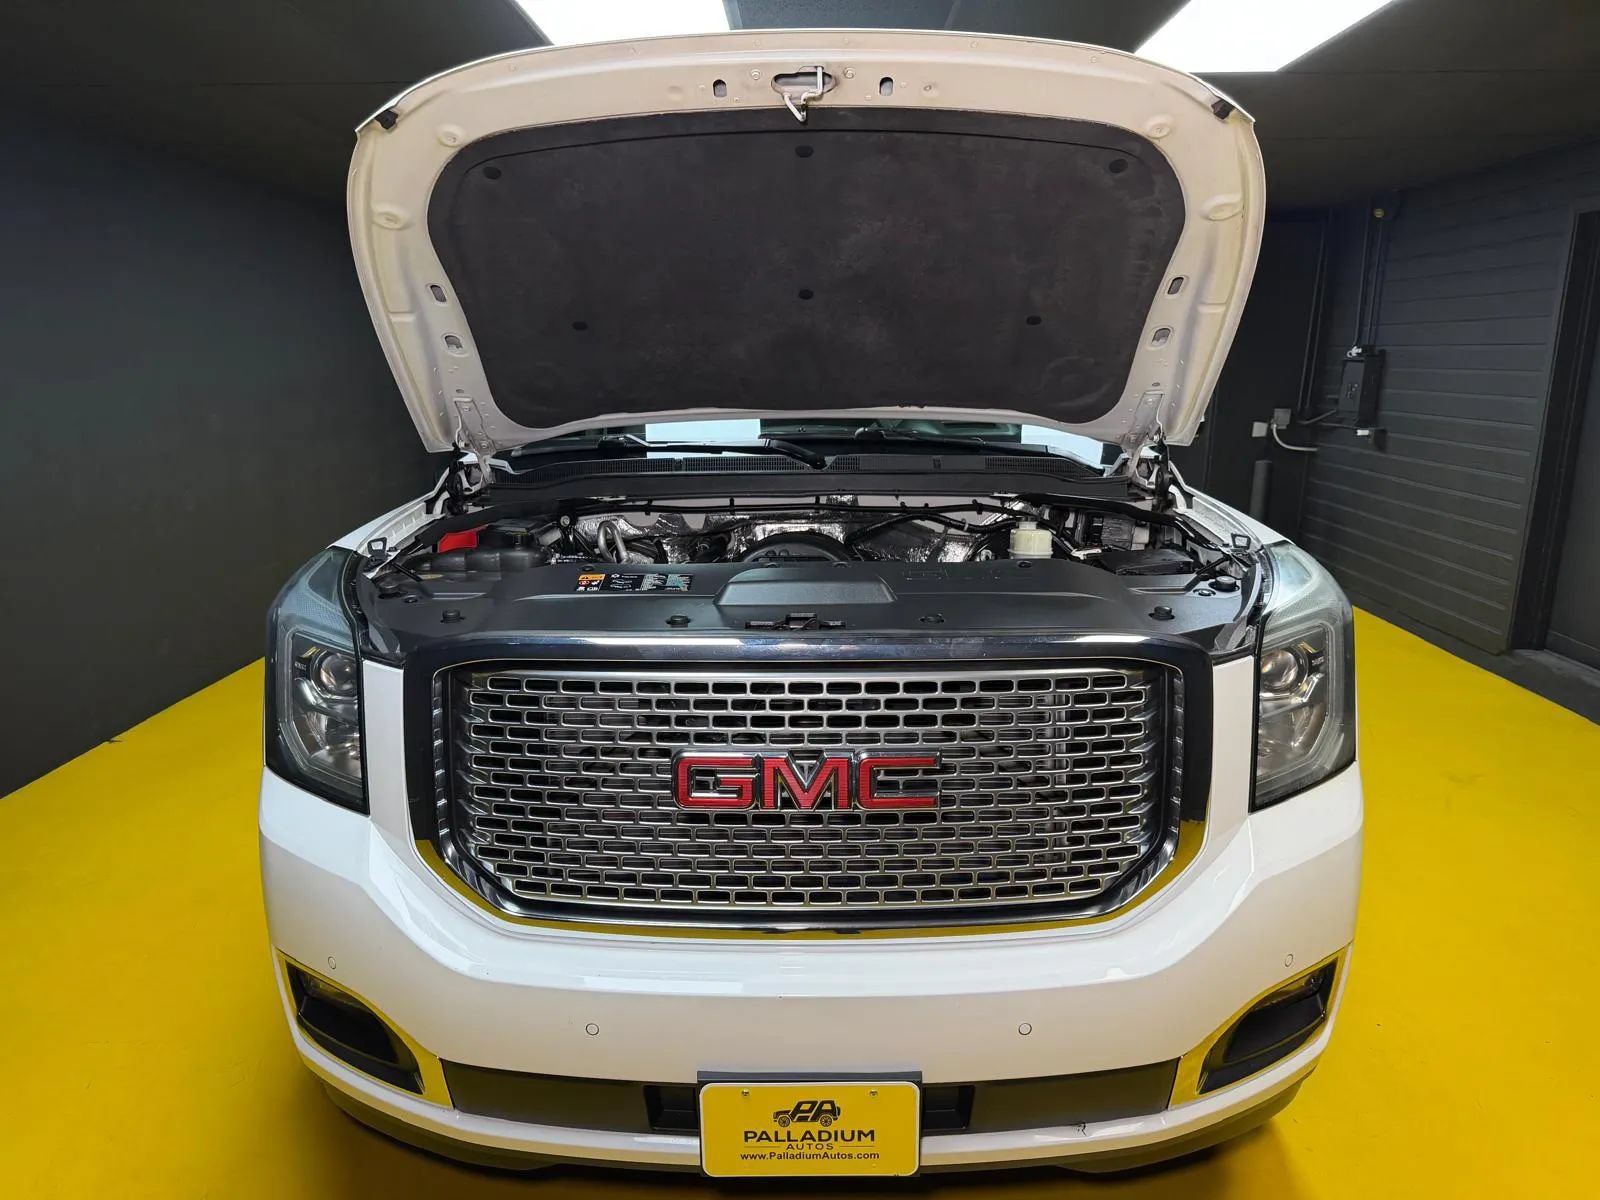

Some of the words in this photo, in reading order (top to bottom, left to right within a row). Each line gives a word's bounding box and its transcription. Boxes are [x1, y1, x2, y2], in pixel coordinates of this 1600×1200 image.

[673, 750, 941, 810] GMC
[743, 1129, 875, 1142] PALLADIUM
[786, 1142, 834, 1150] AUTOS
[740, 1151, 880, 1160] www.PalladiumAutos.com
